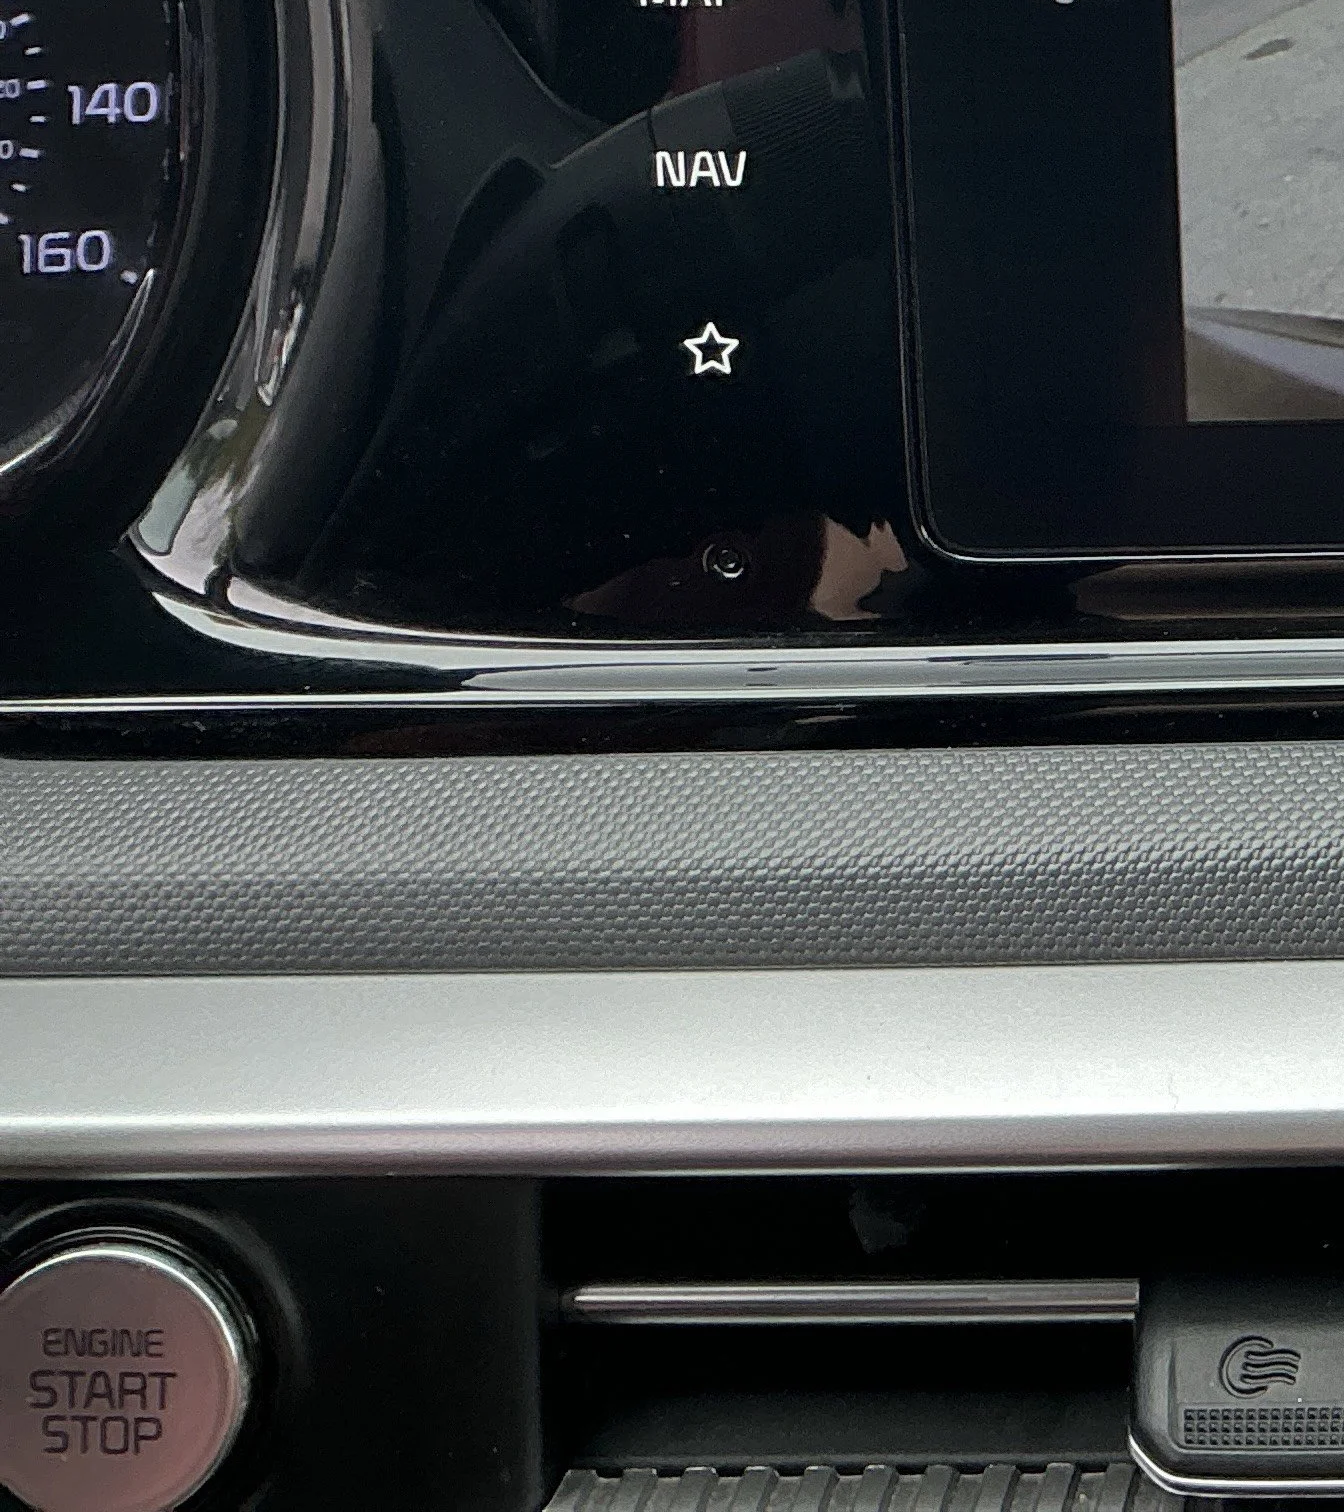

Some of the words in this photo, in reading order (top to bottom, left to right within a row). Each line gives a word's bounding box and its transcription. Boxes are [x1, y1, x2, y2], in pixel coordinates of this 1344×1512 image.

[67, 81, 158, 125] 140
[655, 150, 747, 188] NAV
[18, 229, 111, 275] 160
[42, 1327, 165, 1358] ENGINE
[29, 1369, 178, 1410] START
[42, 1414, 163, 1456] STOP
